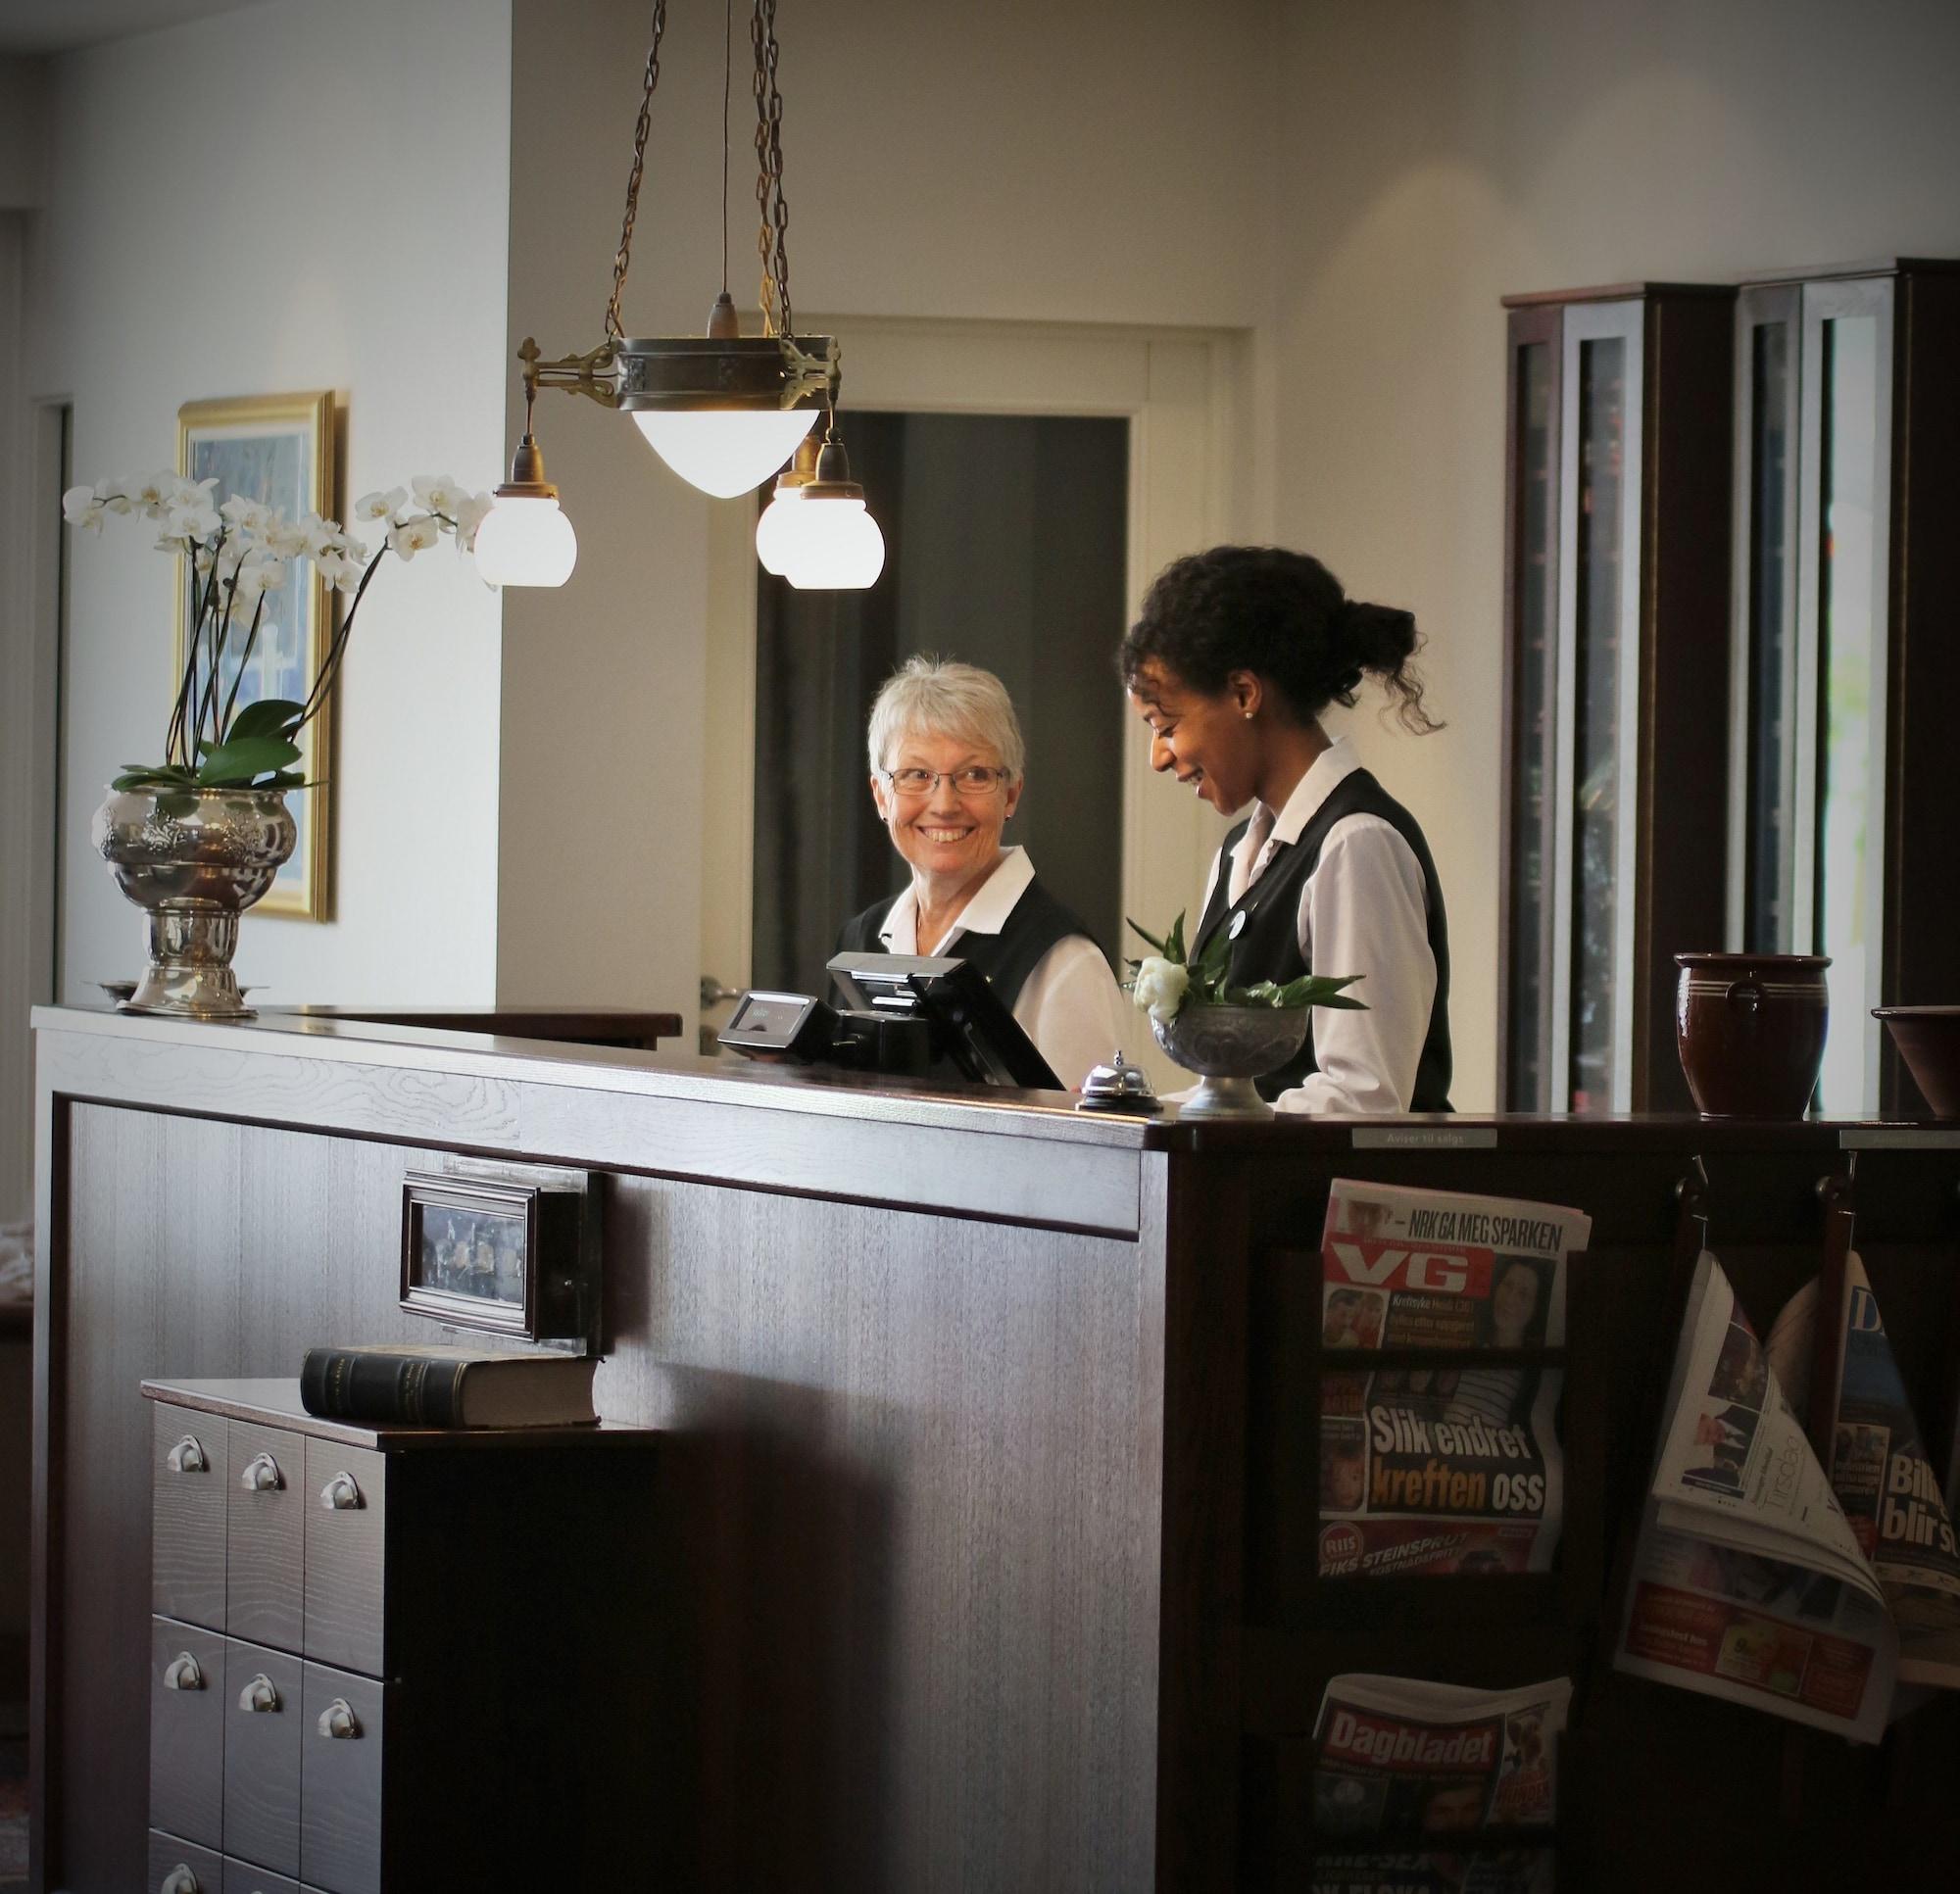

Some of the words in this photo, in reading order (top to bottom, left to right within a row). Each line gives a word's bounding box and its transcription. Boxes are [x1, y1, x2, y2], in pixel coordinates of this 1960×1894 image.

[1421, 1133, 1434, 1144] til
[1408, 1209, 1439, 1238] NRK
[1457, 1213, 1490, 1244] MEG
[1491, 1216, 1563, 1252] SPARKEN
[1331, 1240, 1469, 1292] VG
[1851, 1289, 1886, 1337] D
[1372, 1405, 1432, 1454] Slik
[1435, 1416, 1532, 1459] endret
[1371, 1456, 1488, 1510] kreften
[1492, 1473, 1544, 1511] oss
[1325, 1535, 1357, 1554] RIIS
[1882, 1496, 1938, 1547] blir
[1330, 1710, 1494, 1764] Dagbladet
